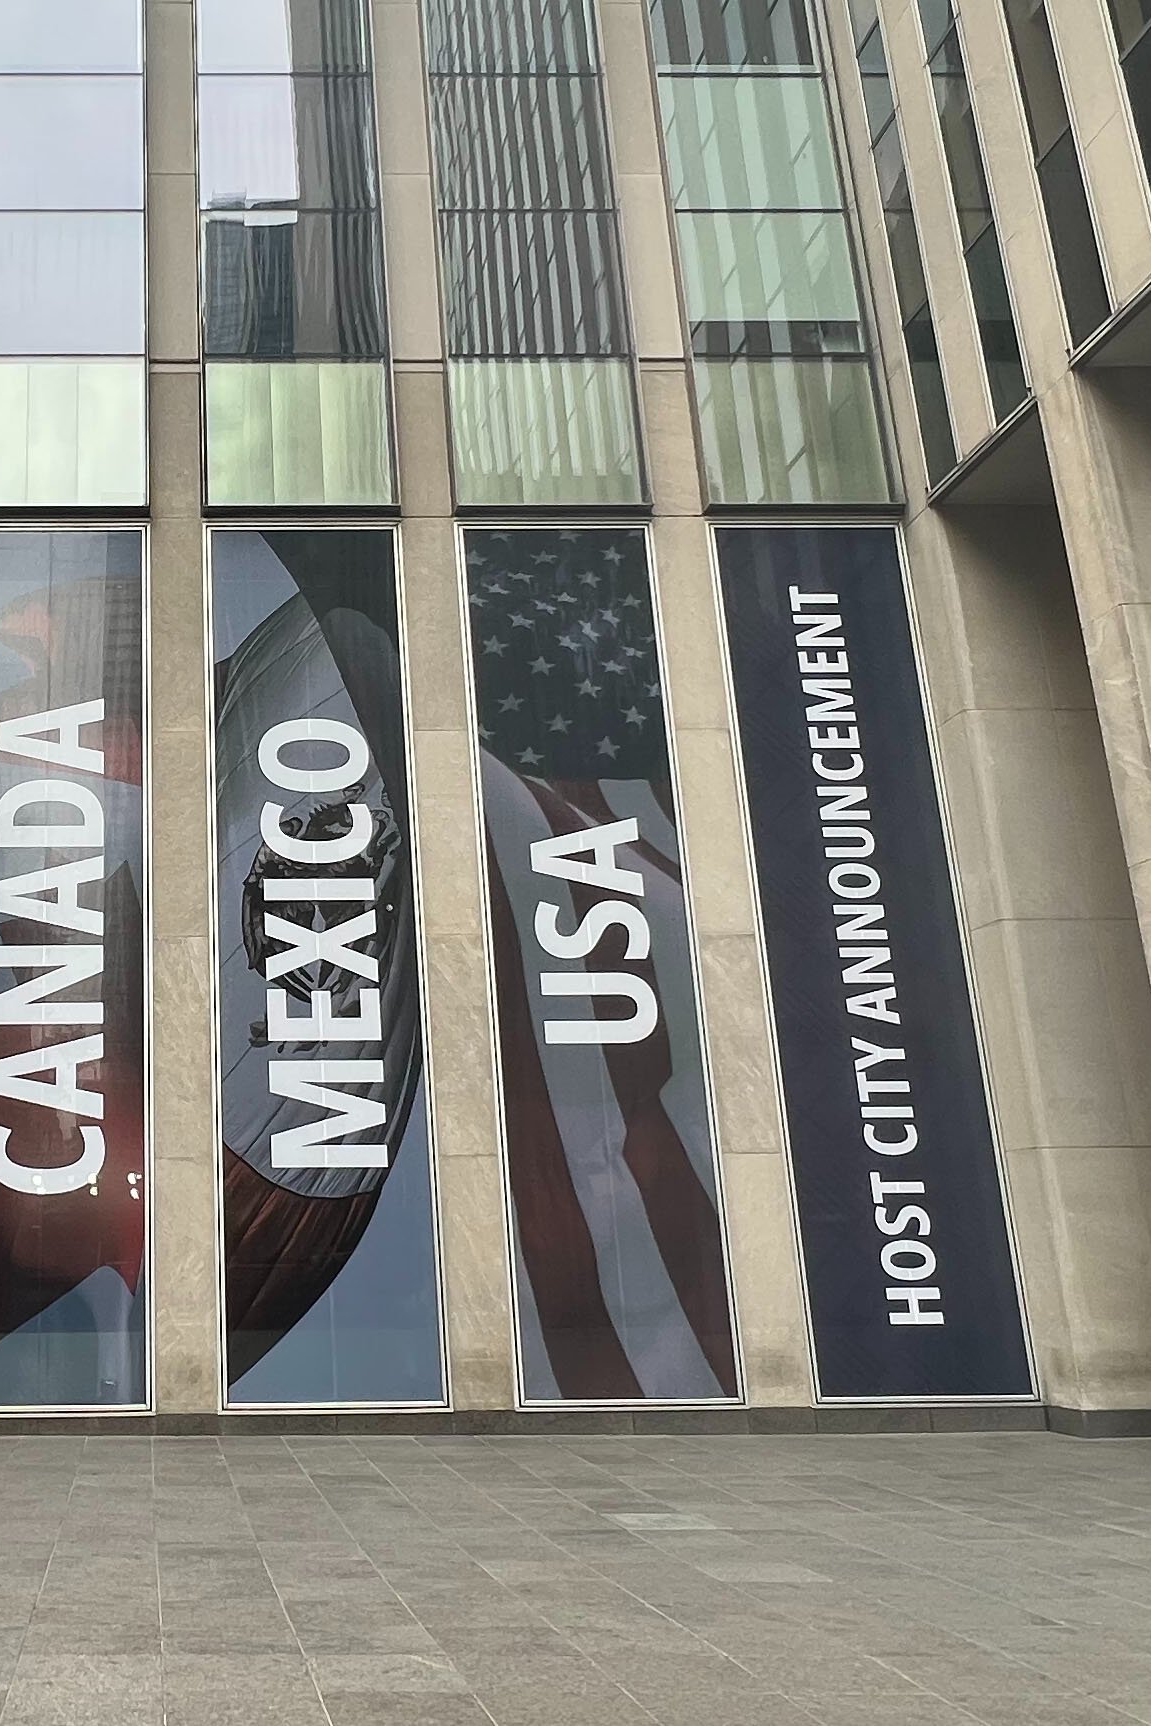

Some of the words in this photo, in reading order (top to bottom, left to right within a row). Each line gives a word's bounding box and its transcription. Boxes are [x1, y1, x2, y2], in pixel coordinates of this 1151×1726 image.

[789, 584, 902, 1025] ANNOUNCEMENT
[257, 718, 389, 1168] MEXICO
[529, 817, 658, 1045] USA
[851, 1036, 918, 1156] CITY
[868, 1171, 945, 1326] HOST
